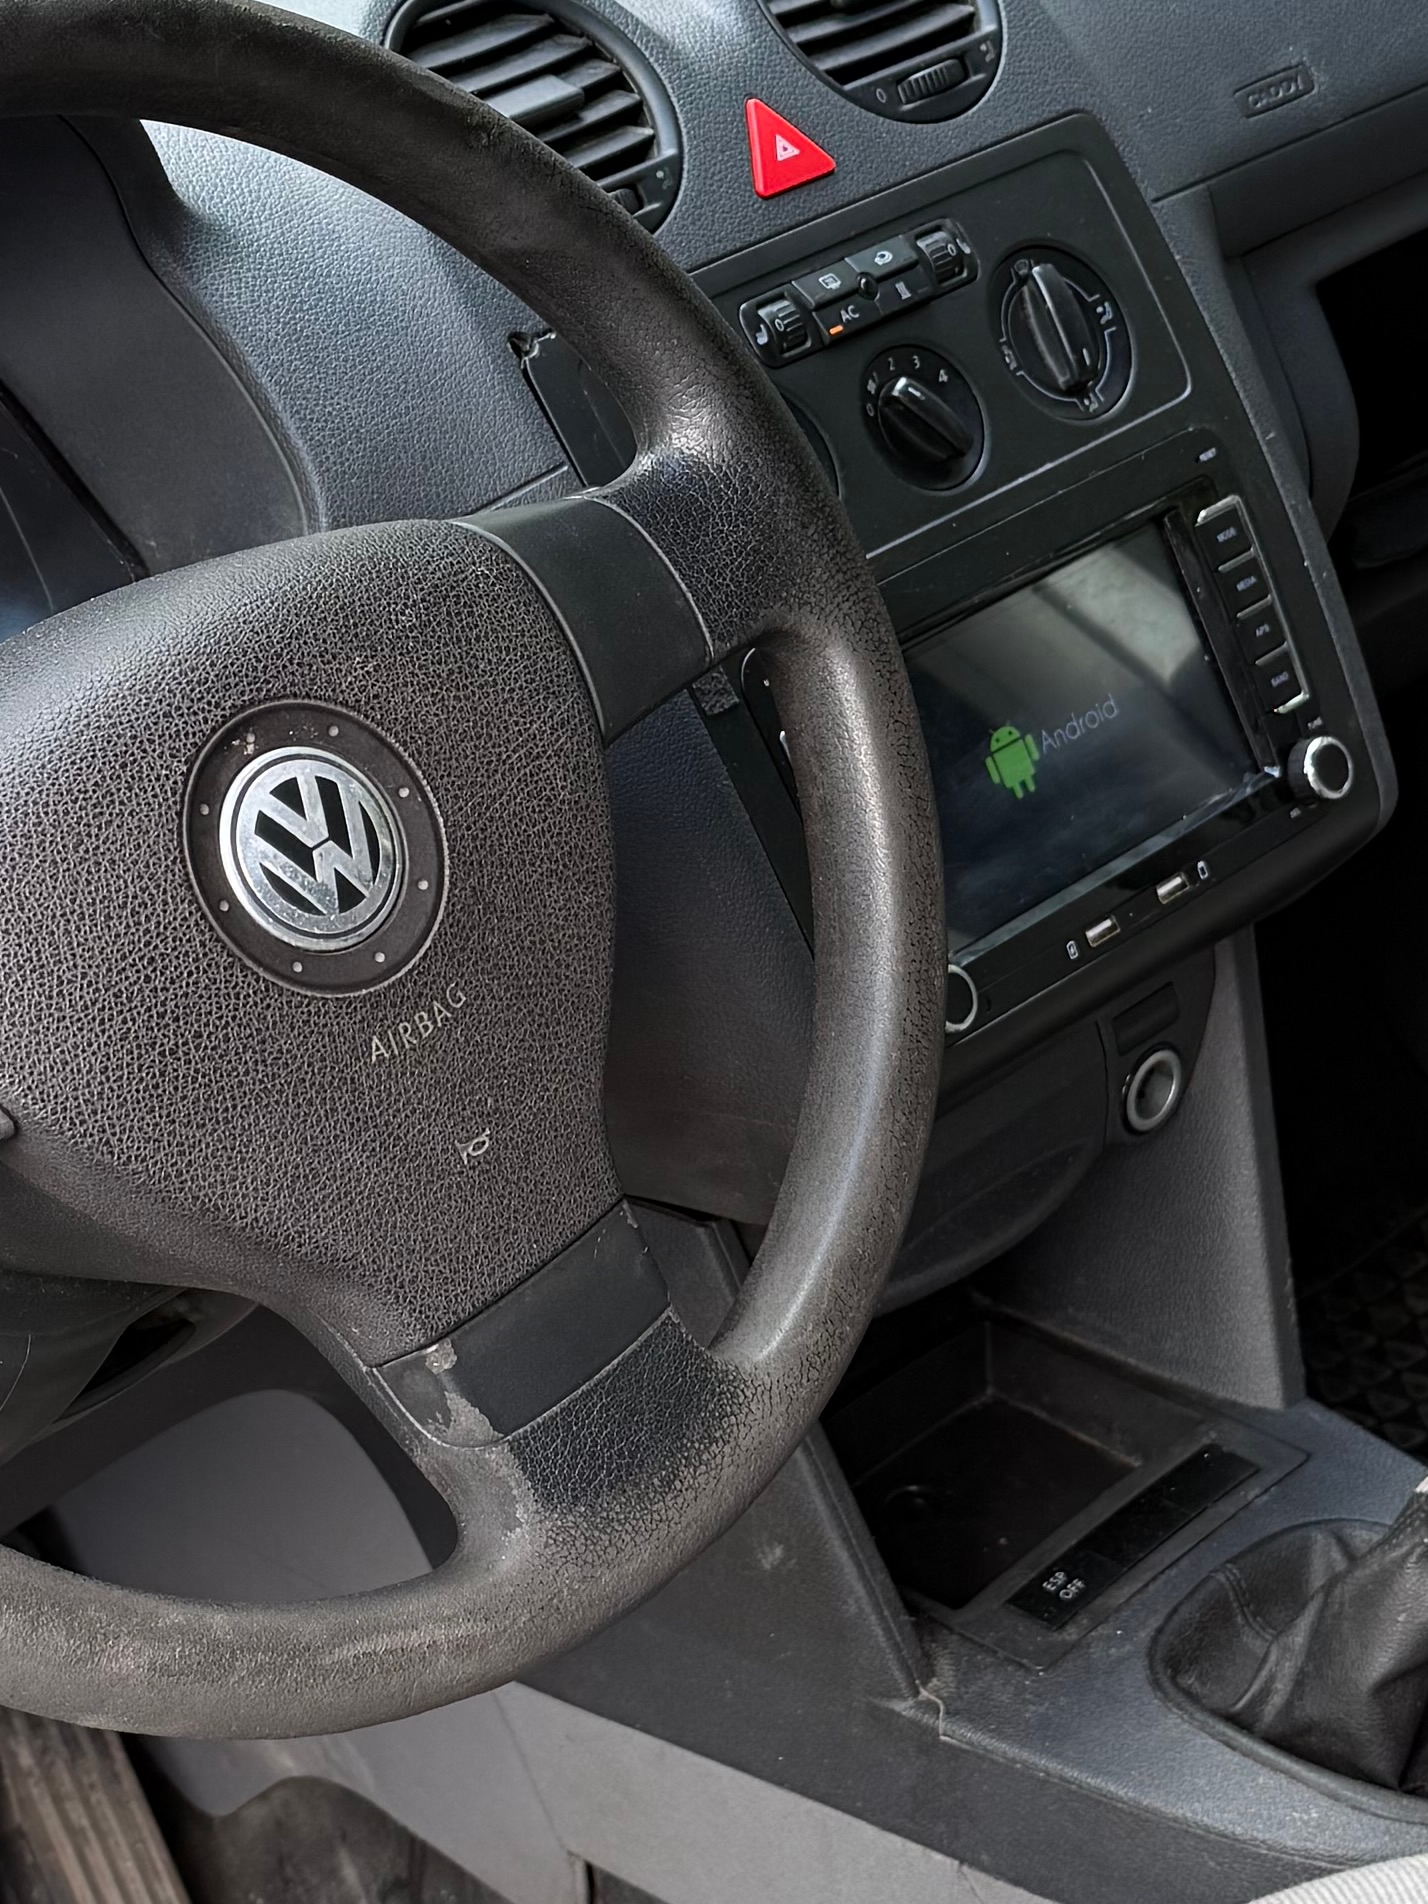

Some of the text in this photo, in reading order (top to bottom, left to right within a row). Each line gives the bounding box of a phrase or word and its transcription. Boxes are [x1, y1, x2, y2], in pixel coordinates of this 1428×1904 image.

[840, 304, 860, 323] AC
[888, 357, 896, 371] 2
[913, 355, 921, 370] 3
[939, 369, 948, 383] 4
[1041, 692, 1119, 755] Android
[371, 981, 466, 1063] AIRBAG
